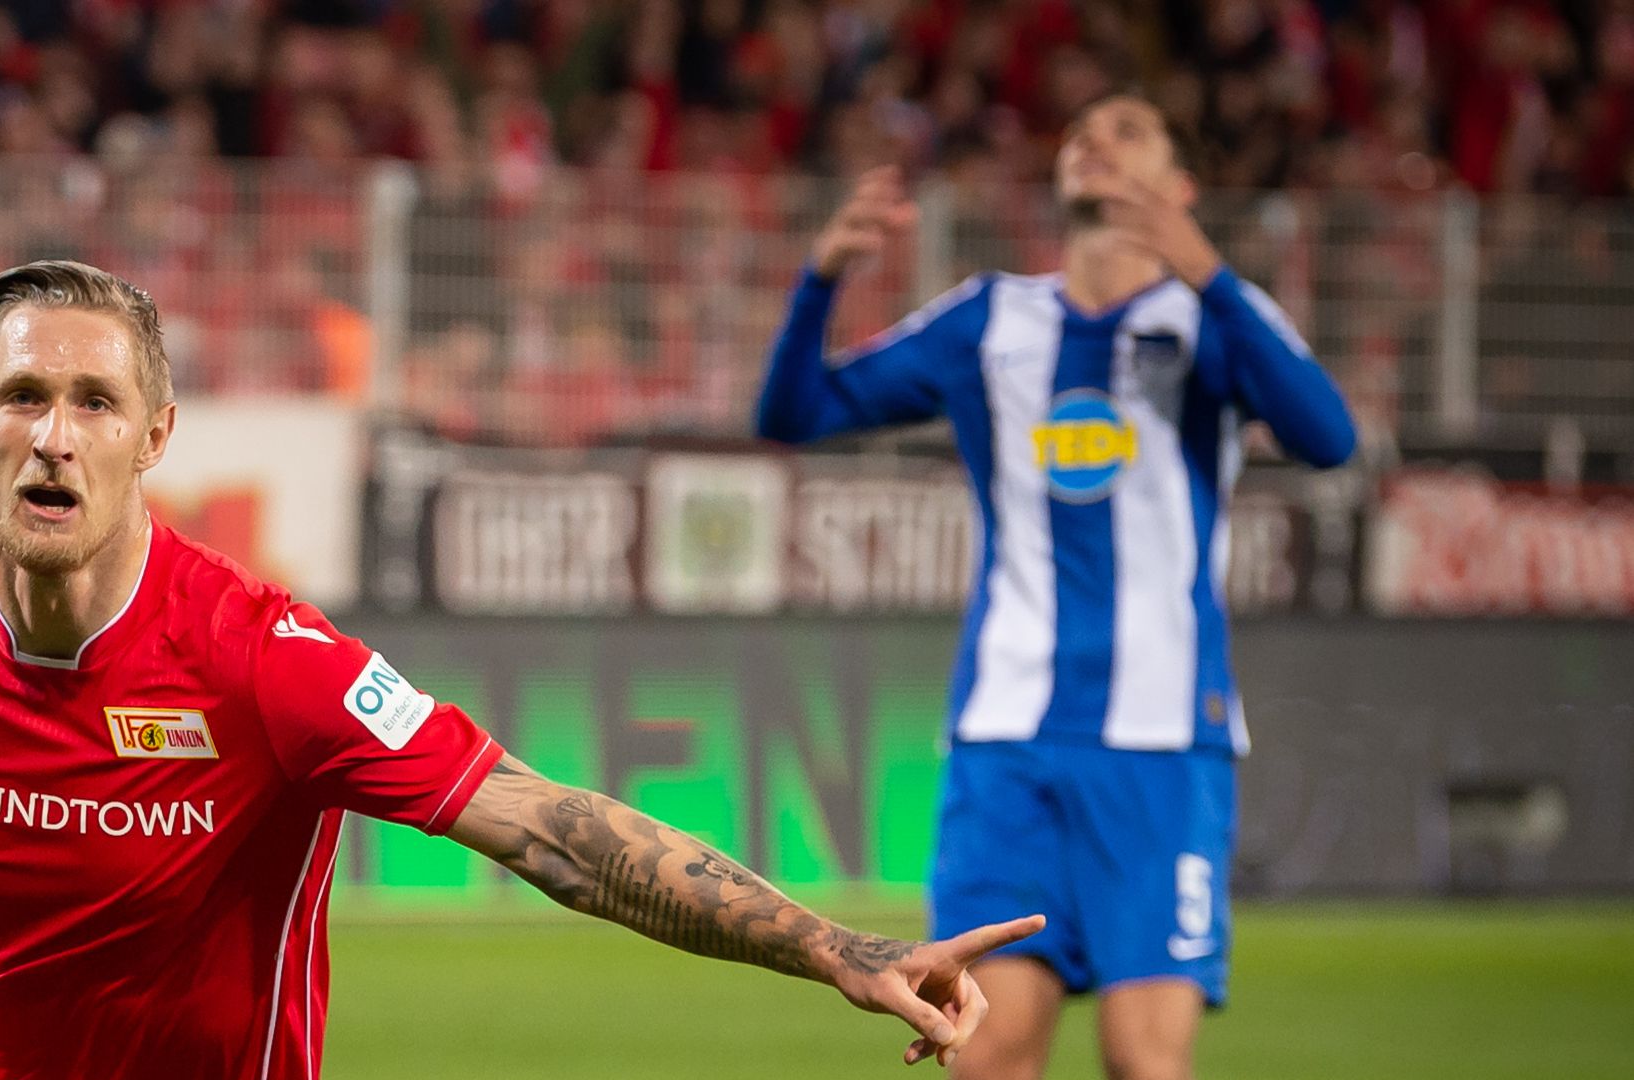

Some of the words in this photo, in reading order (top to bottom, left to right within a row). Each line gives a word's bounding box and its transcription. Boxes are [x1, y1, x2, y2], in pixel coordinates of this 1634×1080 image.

[355, 662, 400, 715] ON
[166, 728, 207, 749] UNION
[1174, 851, 1213, 938] 5
